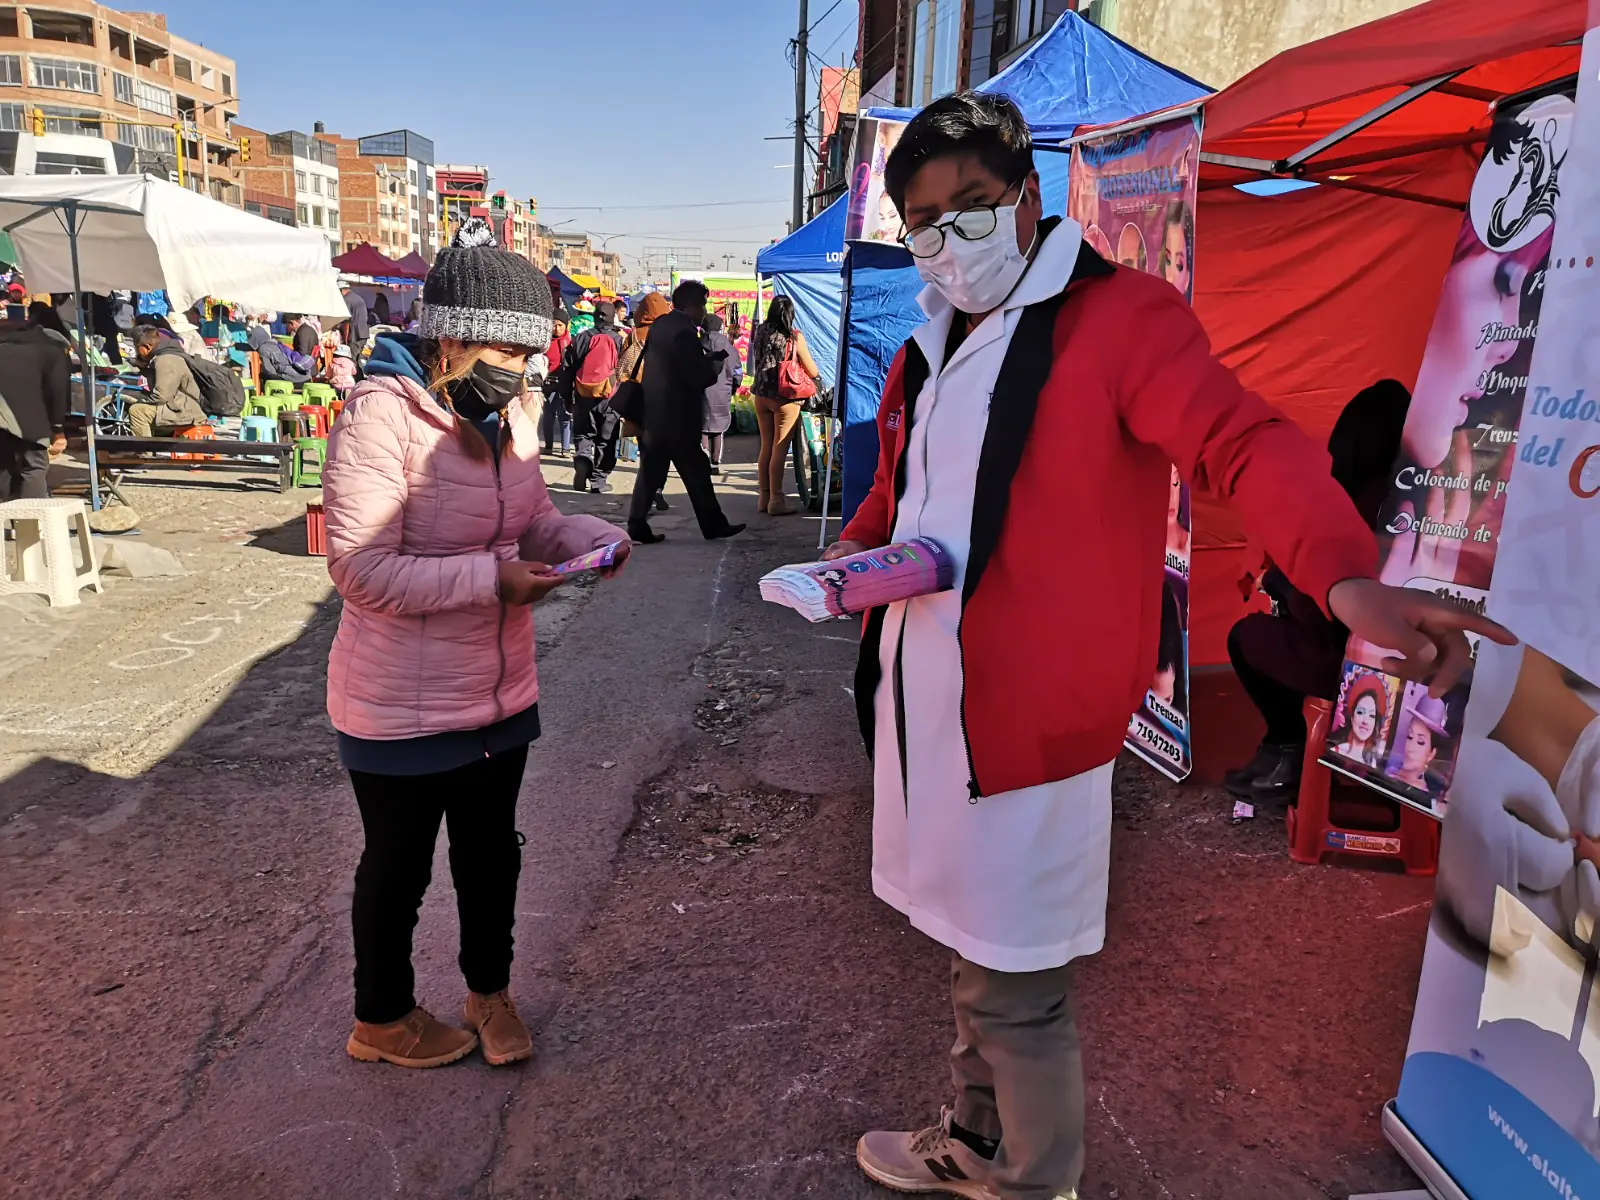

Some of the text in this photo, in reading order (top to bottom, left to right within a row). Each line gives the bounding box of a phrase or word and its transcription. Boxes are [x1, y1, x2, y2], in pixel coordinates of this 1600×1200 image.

[1520, 434, 1564, 467] del
[1395, 466, 1469, 490] Colocado
[1474, 473, 1491, 492] de
[1386, 511, 1491, 543] Delineado de
[1149, 694, 1184, 730] Trenzas
[1137, 721, 1180, 761] 71947203
